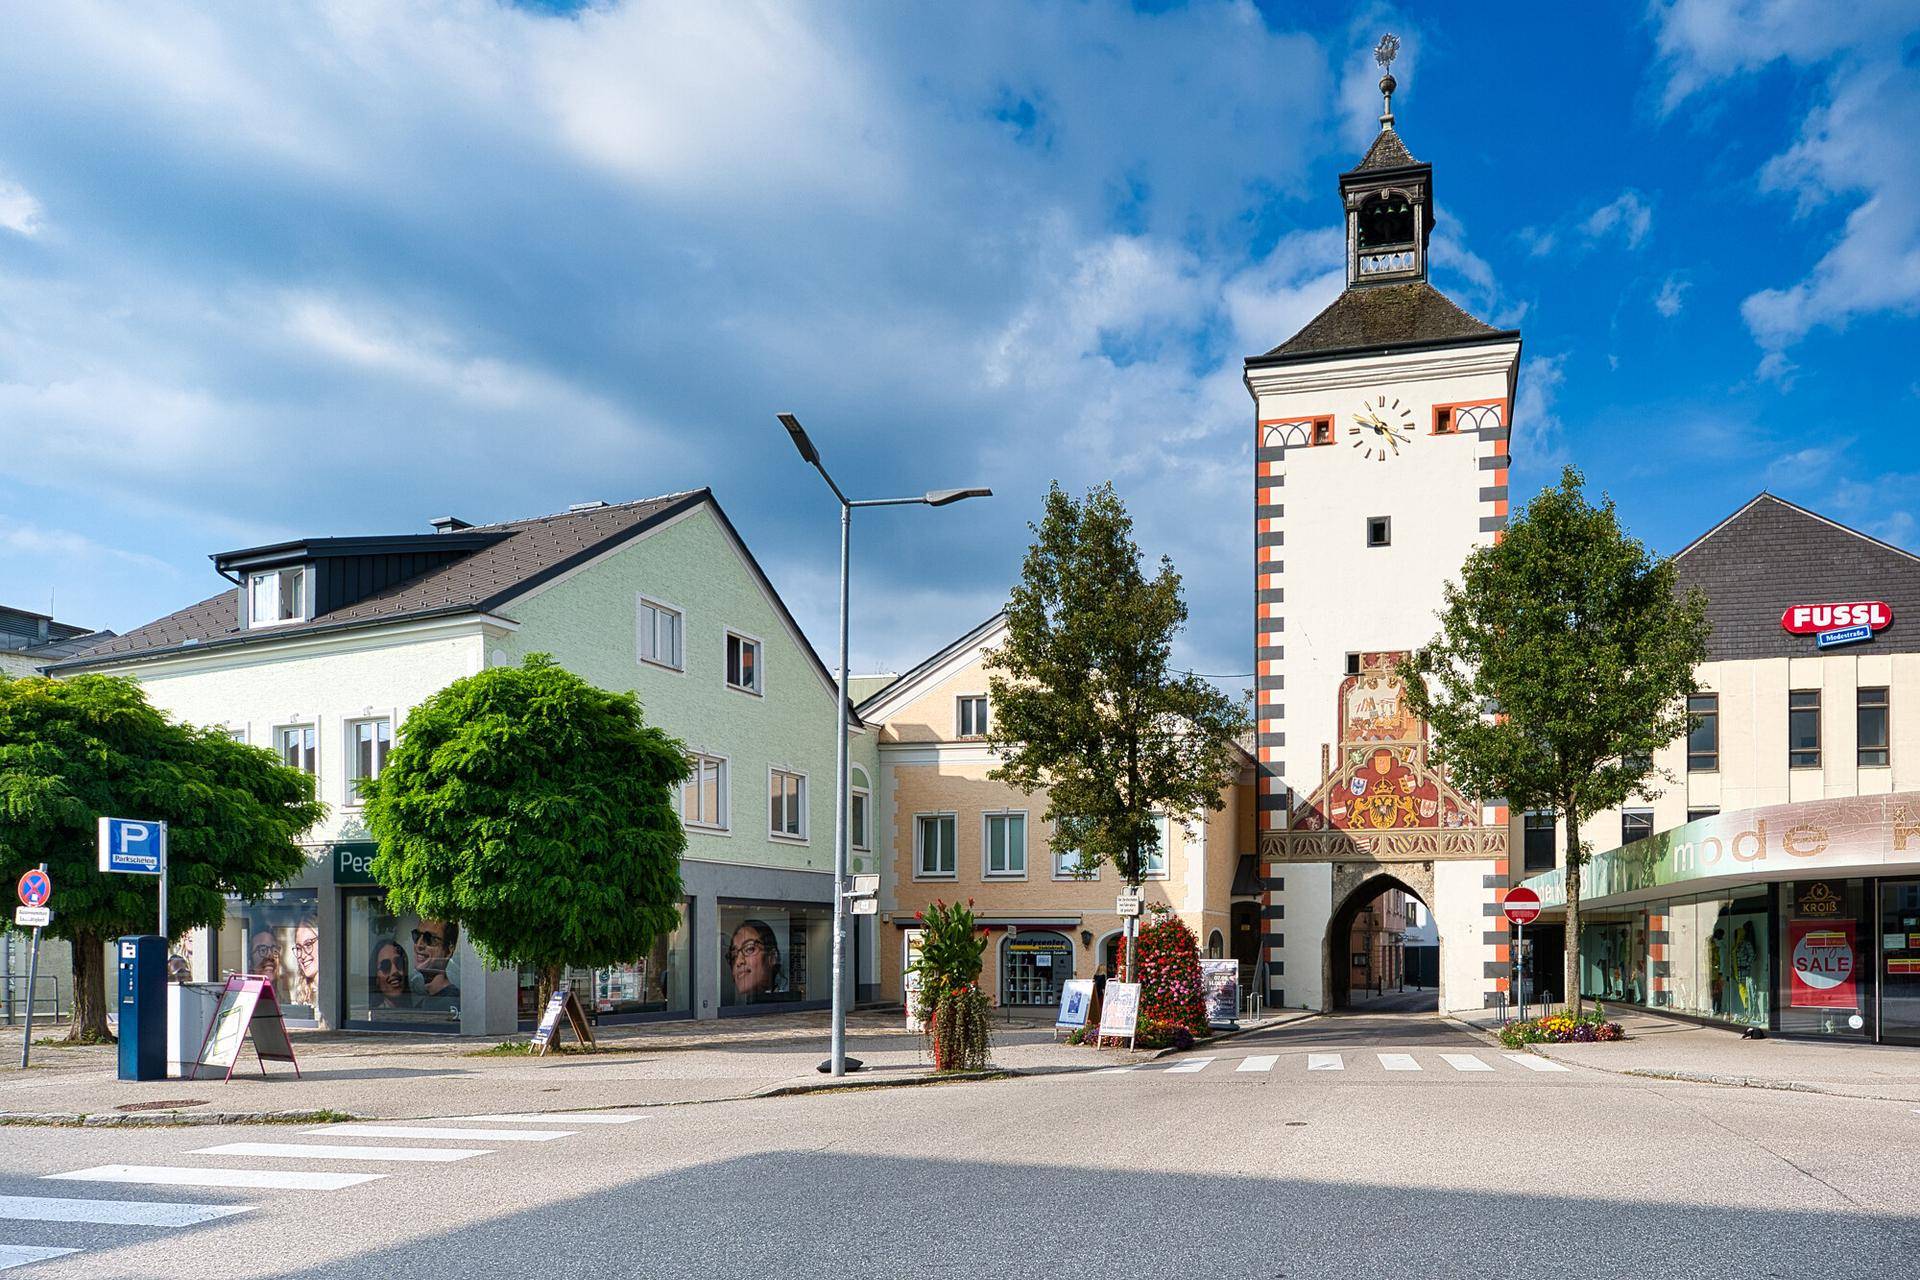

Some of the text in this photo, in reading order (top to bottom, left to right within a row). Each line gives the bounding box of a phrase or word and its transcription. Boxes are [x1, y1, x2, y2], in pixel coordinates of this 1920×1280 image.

[1793, 604, 1886, 628] FUSSL
[1826, 629, 1864, 641] Modestraße
[120, 822, 149, 853] P
[1673, 817, 1829, 873] mode
[114, 854, 156, 864] Parkscheine
[340, 850, 378, 873] Pea
[1796, 957, 1850, 972] SALE
